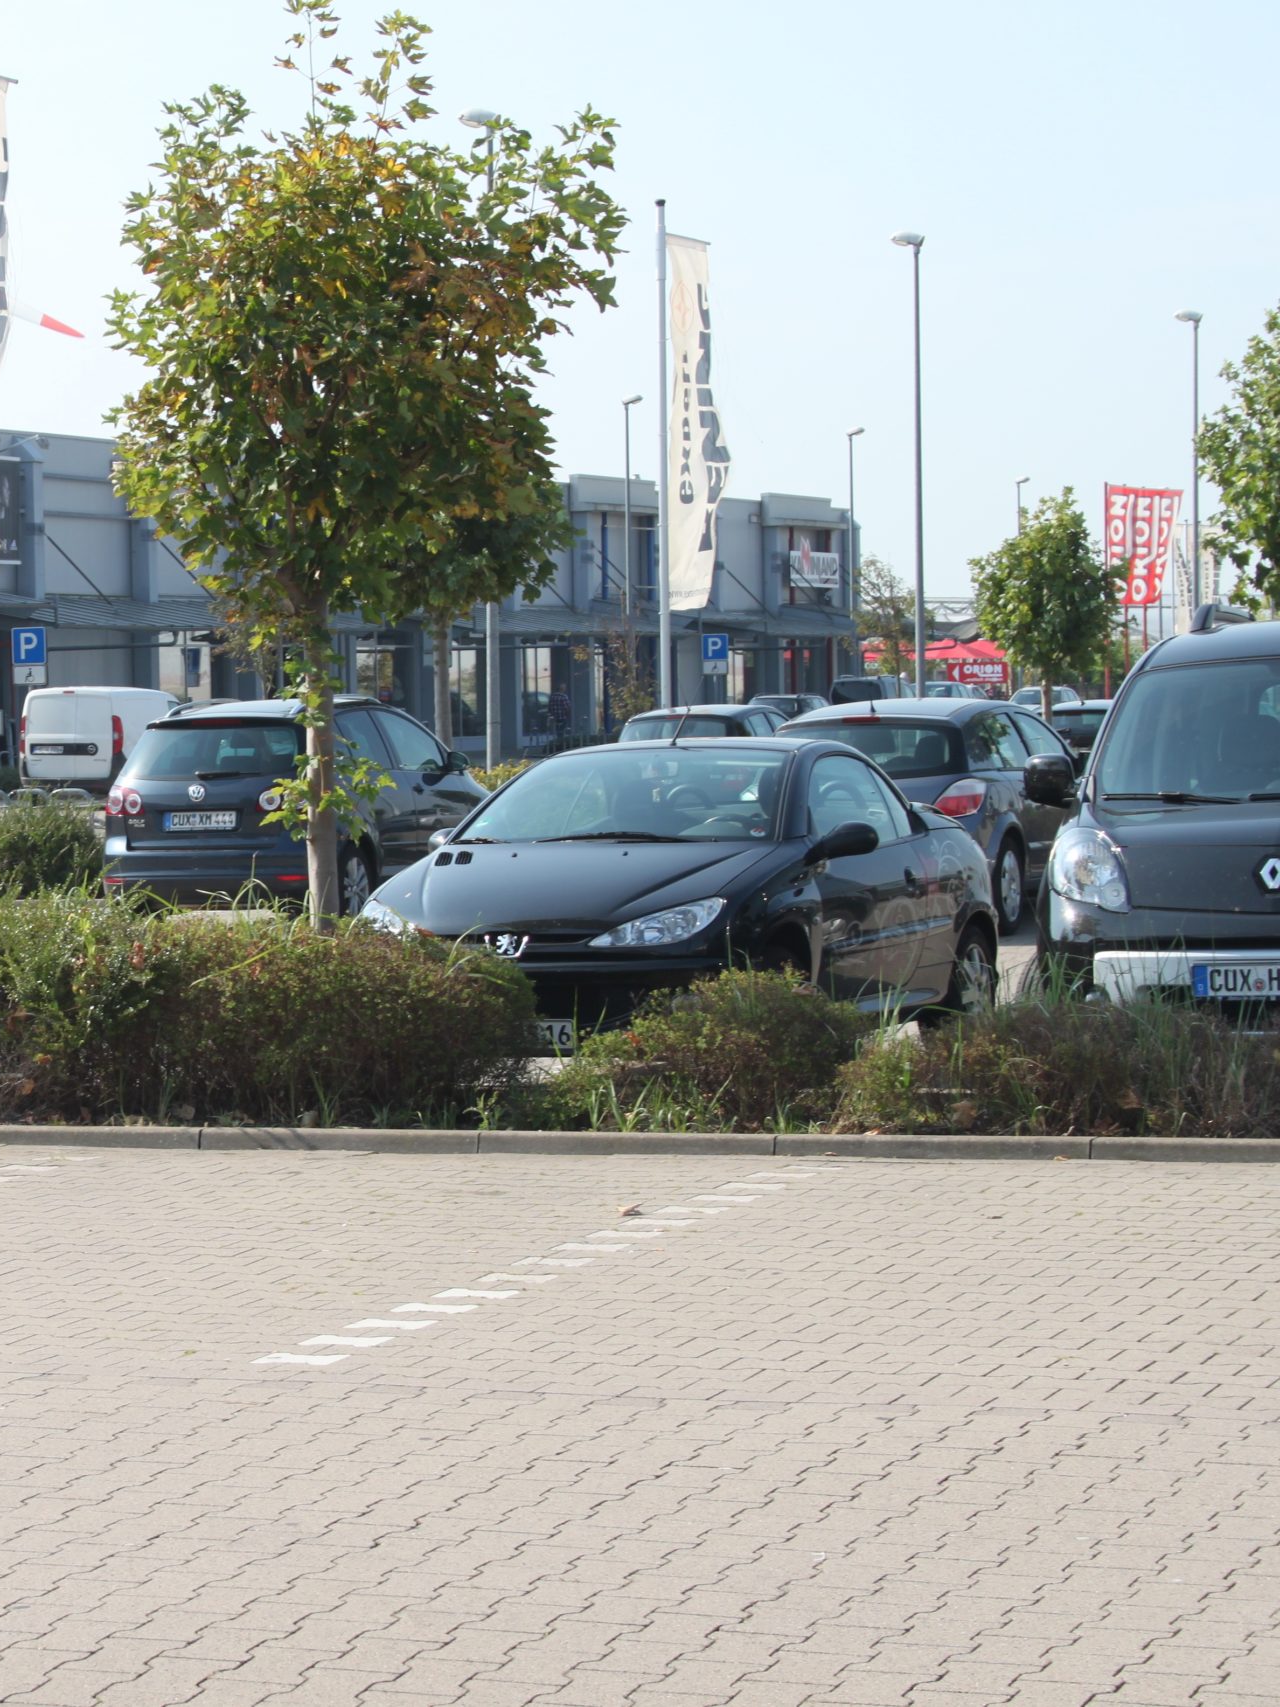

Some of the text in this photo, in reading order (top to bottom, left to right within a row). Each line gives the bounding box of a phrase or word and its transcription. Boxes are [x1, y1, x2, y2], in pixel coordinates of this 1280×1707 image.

[1131, 496, 1156, 602] ORION
[20, 632, 38, 660] P
[708, 638, 722, 657] P
[963, 664, 1003, 674] ORION
[172, 812, 234, 827] CUX XM 444
[1209, 968, 1252, 992] CUX
